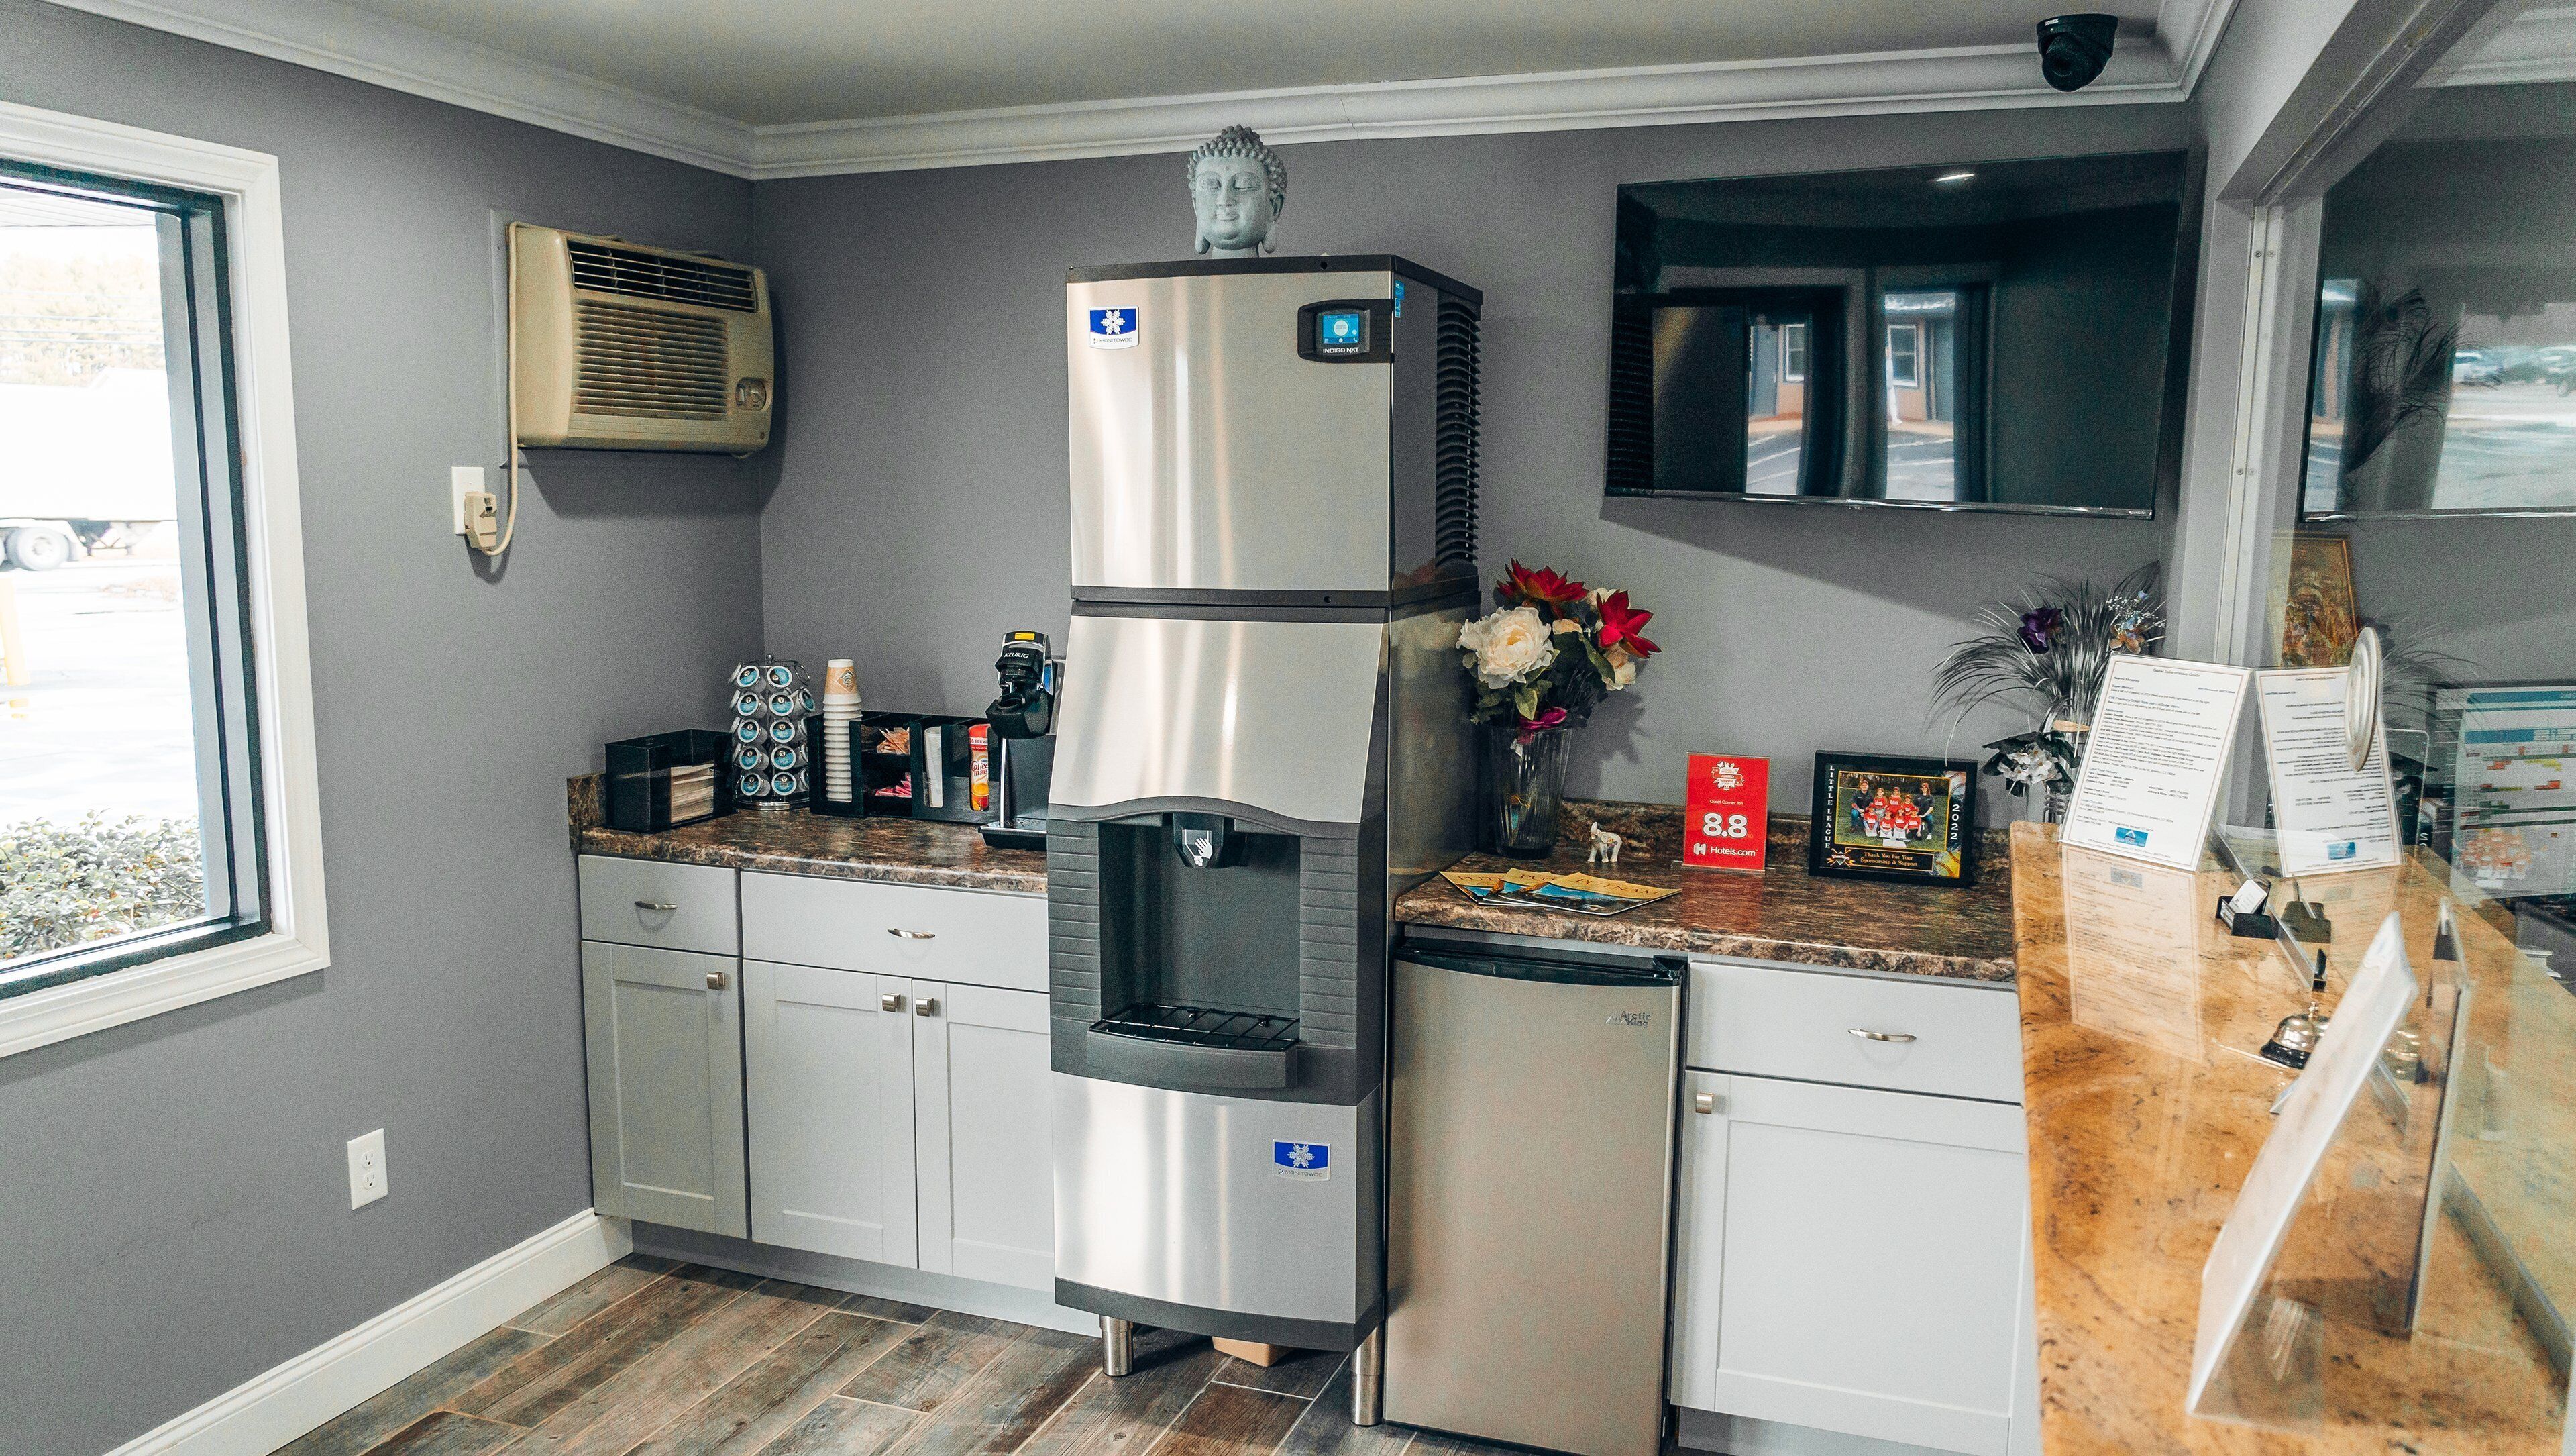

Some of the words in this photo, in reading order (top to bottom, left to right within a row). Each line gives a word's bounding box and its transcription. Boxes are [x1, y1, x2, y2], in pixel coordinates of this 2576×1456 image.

[1703, 813, 1748, 839] 8.8
[1950, 804, 1960, 840] 2022
[1711, 846, 1756, 857] Hotels.com
[1620, 1010, 1651, 1021] Arctic
